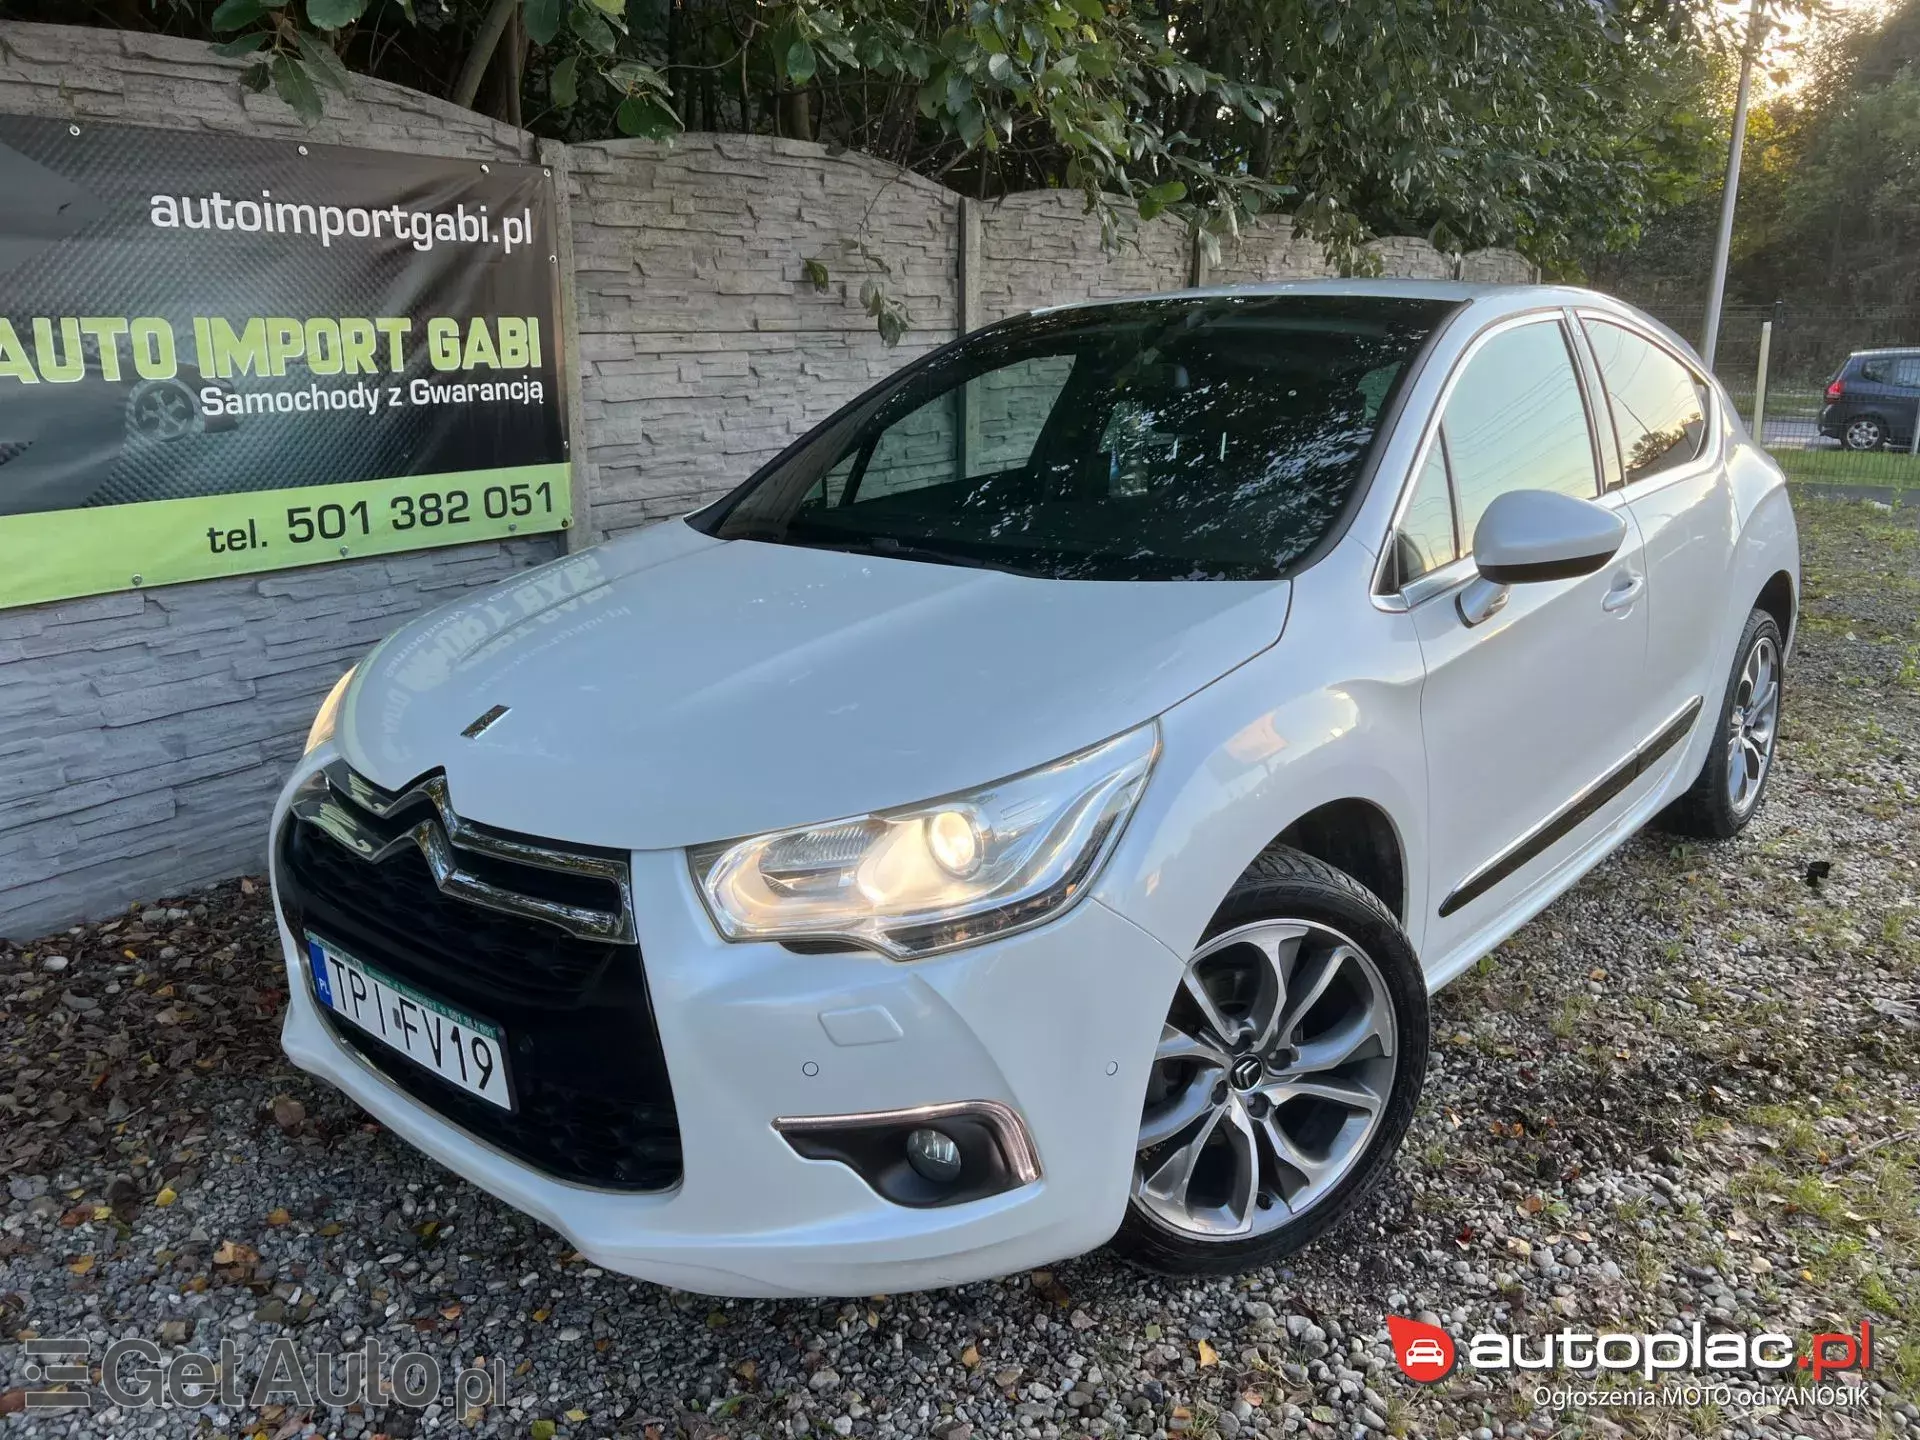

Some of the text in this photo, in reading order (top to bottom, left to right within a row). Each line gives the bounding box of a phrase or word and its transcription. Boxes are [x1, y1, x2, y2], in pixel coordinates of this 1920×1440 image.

[150, 190, 533, 253] autoimportgabi.pl
[0, 316, 542, 384] AUTO IMPORT GABI
[200, 376, 544, 416] Samochody z Gwarancją
[207, 481, 553, 554] tel. 501 382 051
[319, 978, 330, 995] PL
[329, 956, 386, 1036] TPI
[398, 996, 493, 1090] FV19
